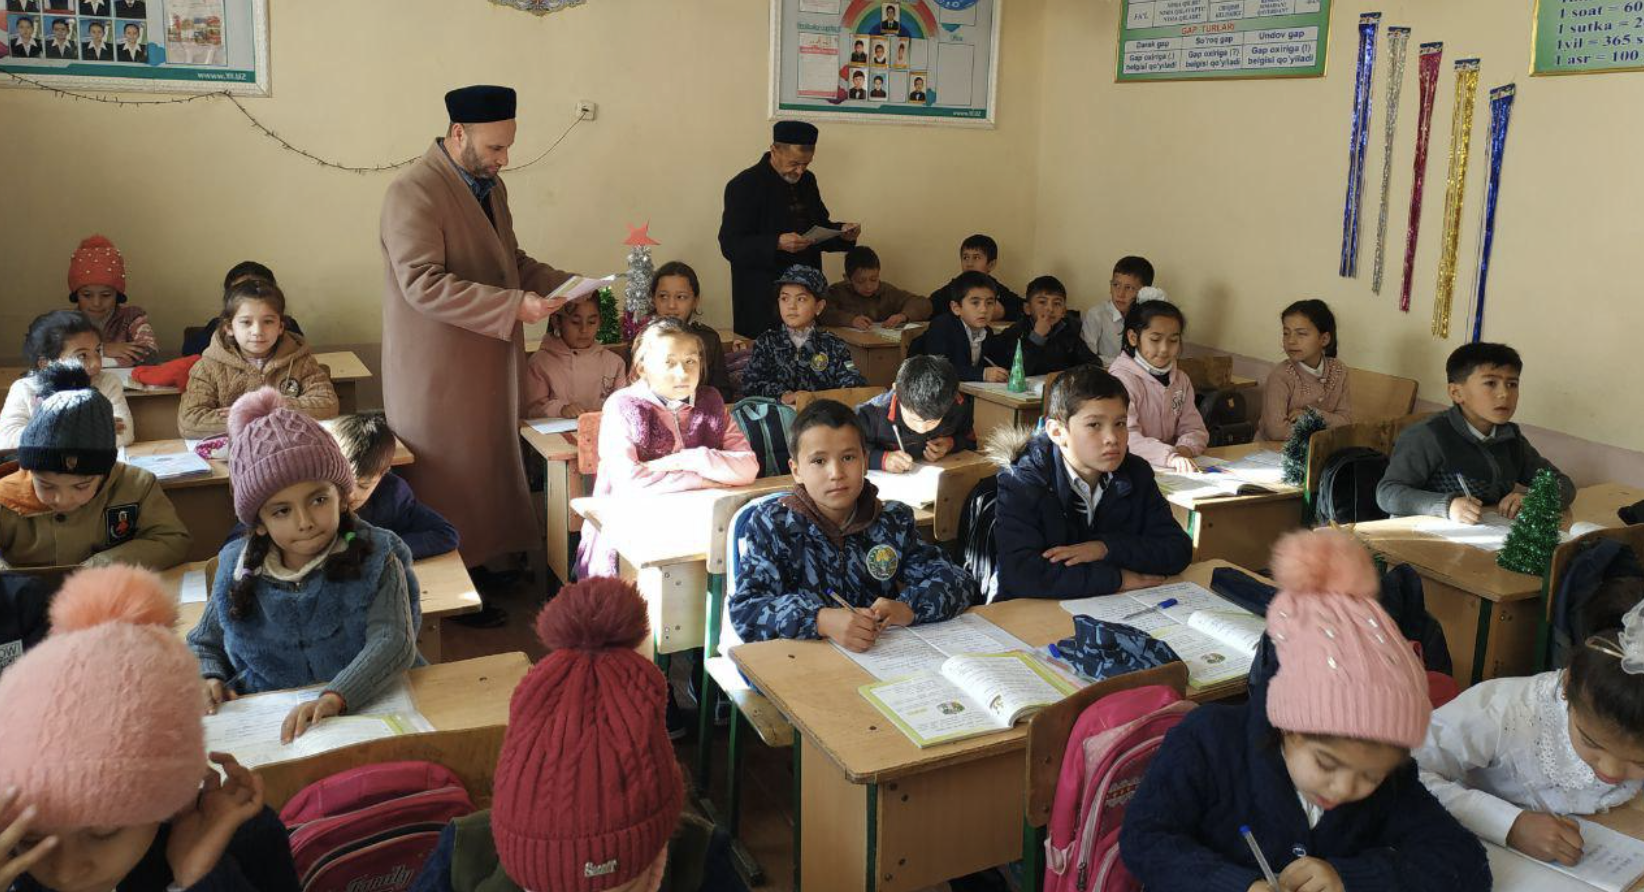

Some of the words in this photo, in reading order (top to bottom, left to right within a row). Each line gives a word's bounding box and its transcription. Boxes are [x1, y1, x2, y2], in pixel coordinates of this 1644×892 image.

[1572, 6, 1603, 17] soat
[1624, 1, 1644, 12] 60
[1181, 26, 1198, 34] GAP
[1202, 23, 1235, 33] TURLARI
[1570, 21, 1612, 33] sutka
[1634, 17, 1644, 28] 2
[1220, 36, 1234, 45] gap
[1259, 31, 1286, 40] Undov
[1288, 31, 1305, 40] gap
[1602, 34, 1631, 47] 365
[1157, 41, 1170, 49] gap
[1188, 50, 1202, 59] Gap
[1251, 46, 1269, 56] Gap
[1270, 45, 1300, 54] oxiriga
[1130, 54, 1143, 62] Gap
[1247, 55, 1275, 65] belgisi
[1567, 55, 1591, 65] asr
[1612, 50, 1639, 62] 100
[1185, 60, 1209, 68] belgisi
